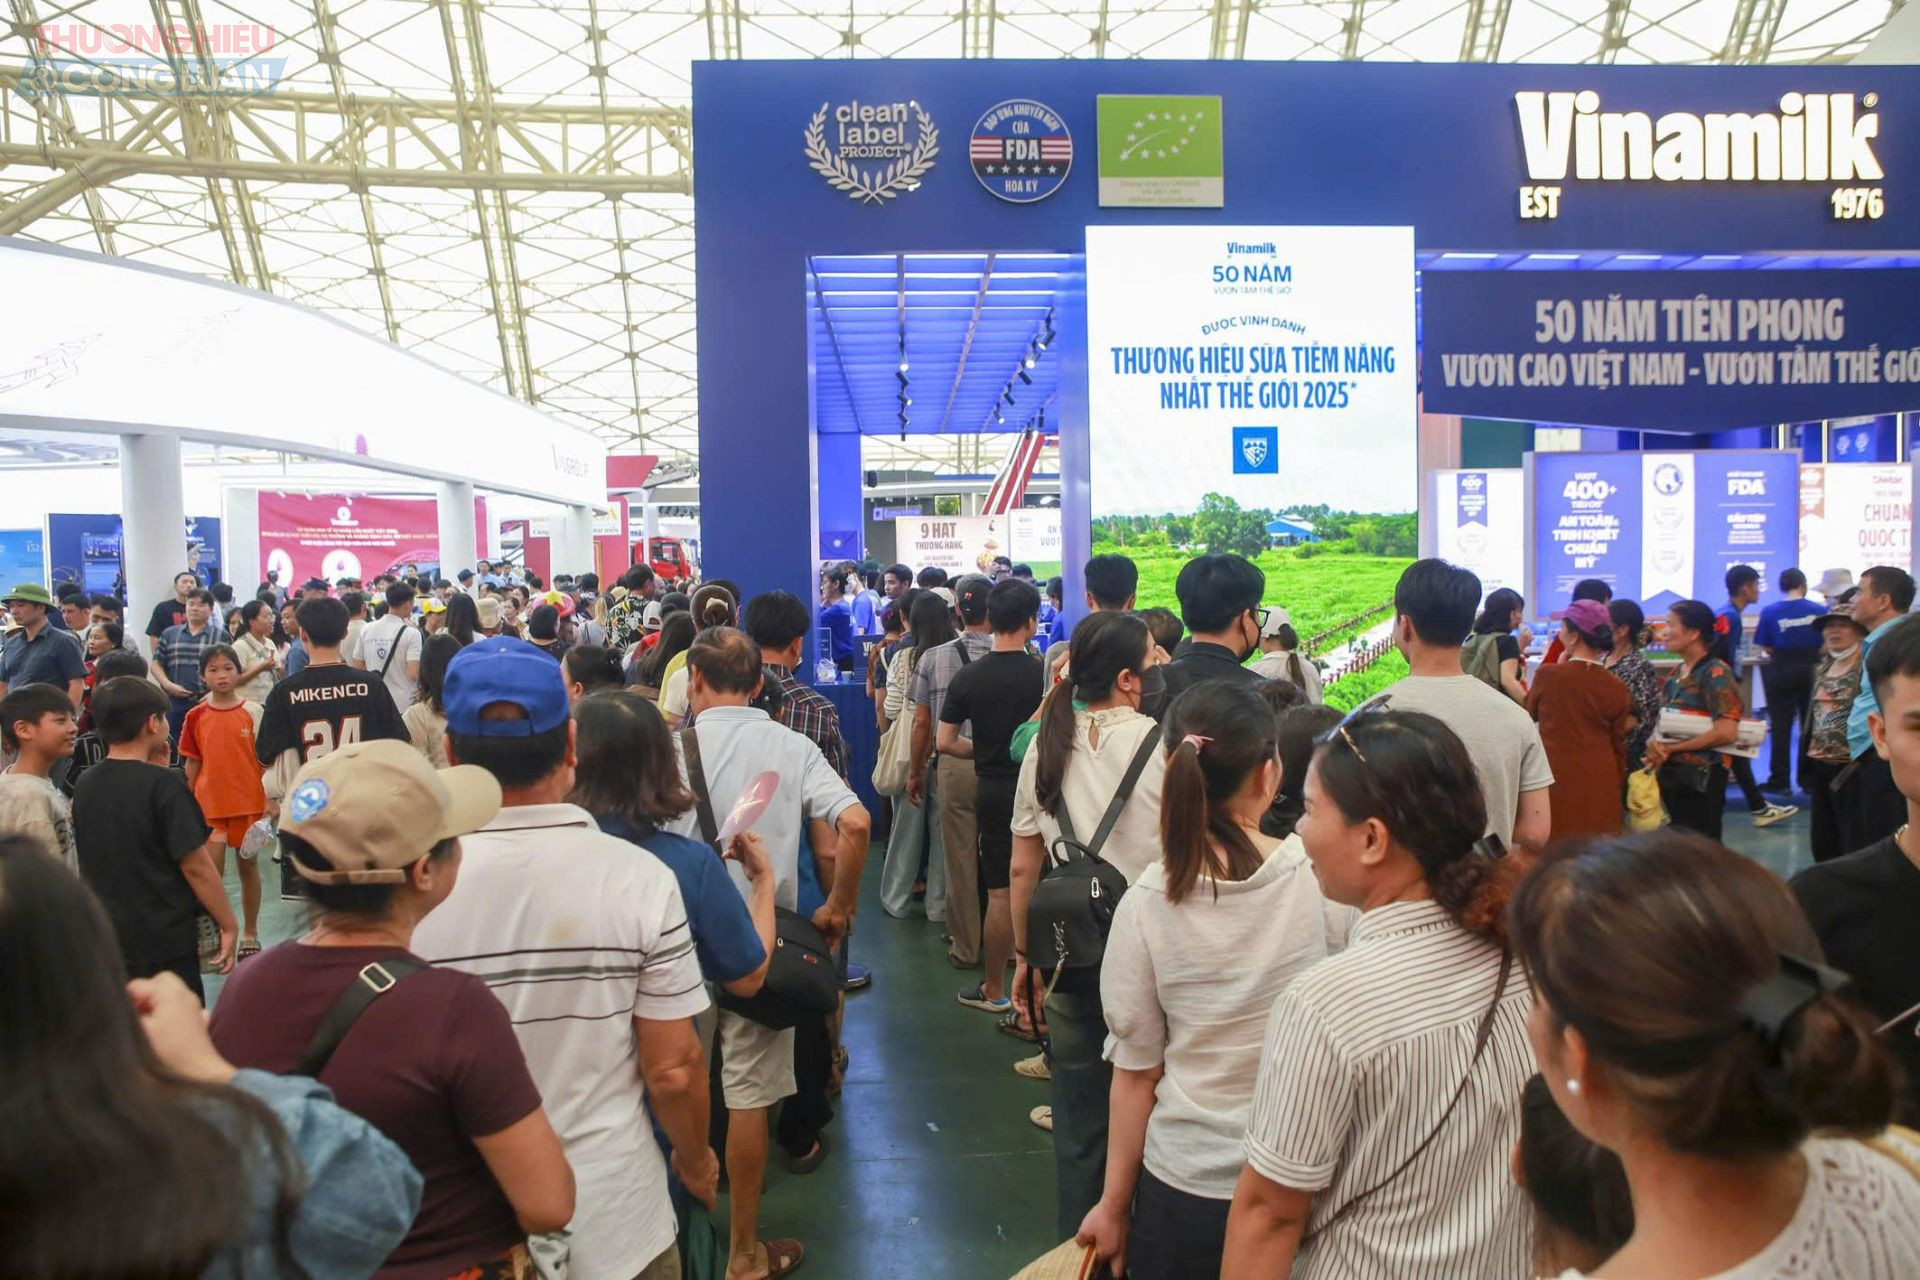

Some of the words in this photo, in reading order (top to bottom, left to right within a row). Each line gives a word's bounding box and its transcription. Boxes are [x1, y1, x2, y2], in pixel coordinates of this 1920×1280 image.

[835, 99, 908, 123] clean
[839, 121, 904, 145] label
[1514, 89, 1884, 181] Vinamilk
[839, 145, 904, 158] PROJECT
[1005, 138, 1040, 160] FDA
[1005, 179, 1024, 193] HOA
[1519, 186, 1561, 219] EST
[1831, 187, 1884, 220] 1976
[1227, 241, 1277, 254] Vinamilk
[1212, 264, 1240, 283] 50
[1239, 315, 1270, 326] VINH
[1271, 317, 1306, 335] DANH
[1535, 299, 1577, 343] 50
[1582, 292, 1657, 343] NĂM
[1737, 298, 1844, 342] PHONG
[1110, 345, 1195, 374] THƯƠNG
[1200, 342, 1244, 377] HIỆU
[1249, 342, 1288, 374] SỮA
[1292, 339, 1339, 373] TIỀM
[1344, 342, 1395, 373] NĂNG
[1441, 352, 1514, 388] VƯƠN
[1518, 352, 1568, 388] CAO
[1570, 348, 1625, 391] VIỆT
[1628, 352, 1686, 387] NAM
[1702, 351, 1774, 386] VƯƠN
[1777, 344, 1831, 385] TẦM
[1834, 343, 1881, 384] THẾ
[1160, 375, 1212, 409] NHẤT
[1217, 375, 1254, 409] THẾ
[1259, 377, 1299, 409] GIỚI
[1562, 480, 1618, 500] 400+
[1727, 478, 1766, 496] FDA
[920, 522, 930, 539] 9
[289, 683, 369, 705] MIKENCO
[301, 714, 362, 763] 24
